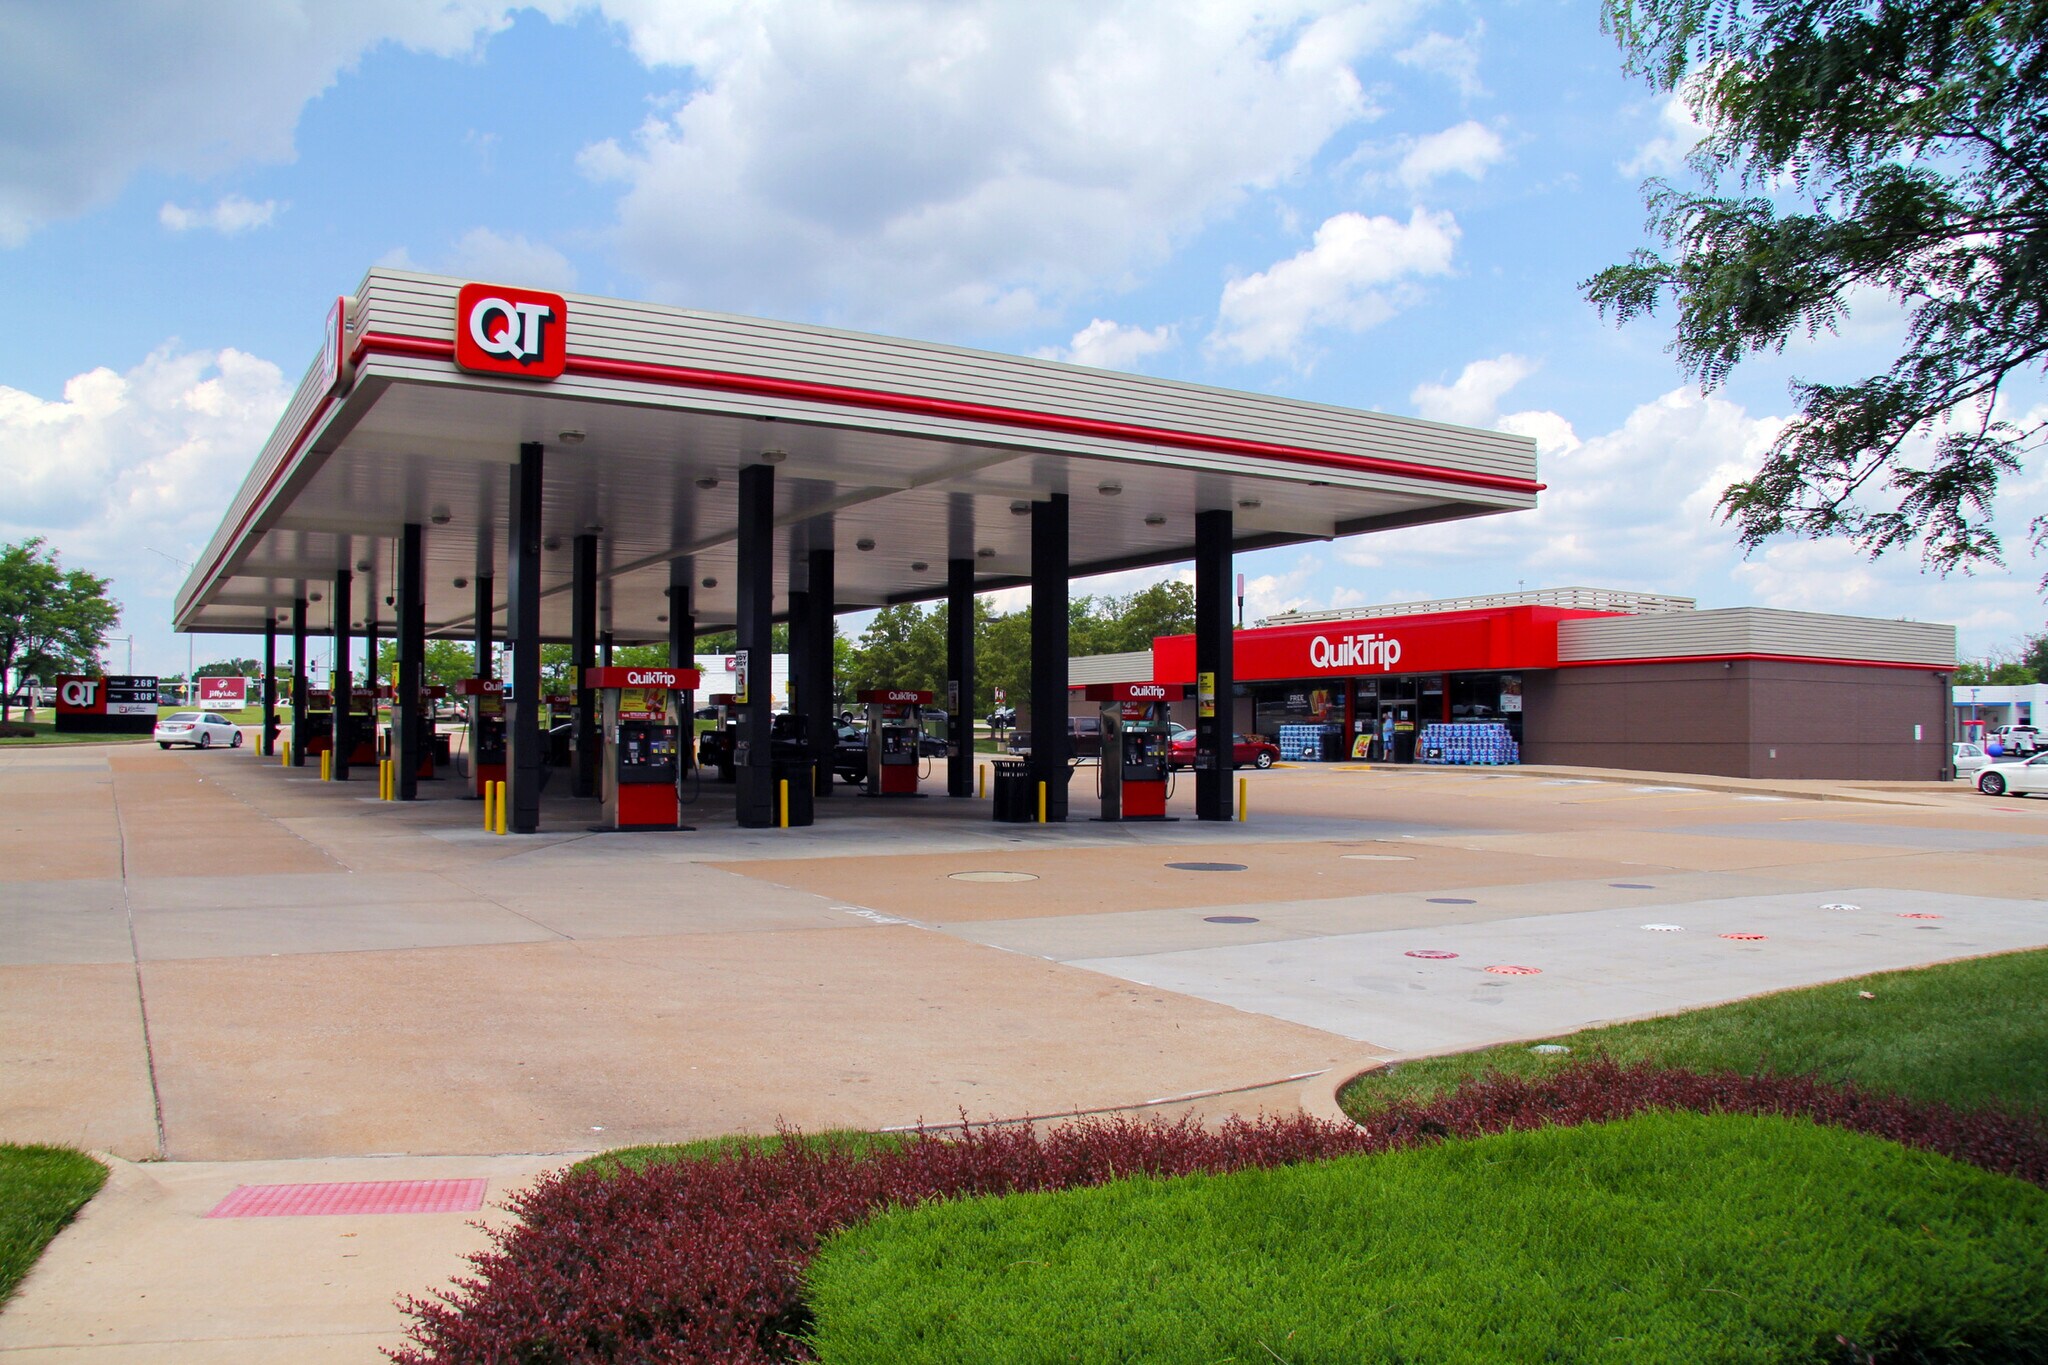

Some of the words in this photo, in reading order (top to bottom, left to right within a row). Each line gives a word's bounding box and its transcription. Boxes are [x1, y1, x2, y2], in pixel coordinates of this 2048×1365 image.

[469, 297, 550, 360] QT
[1309, 632, 1402, 671] QuikTrip
[627, 671, 676, 688] QuikTrip
[62, 681, 99, 707] QT
[888, 690, 919, 704] QuikTrip
[1130, 685, 1165, 699] QuikTrip
